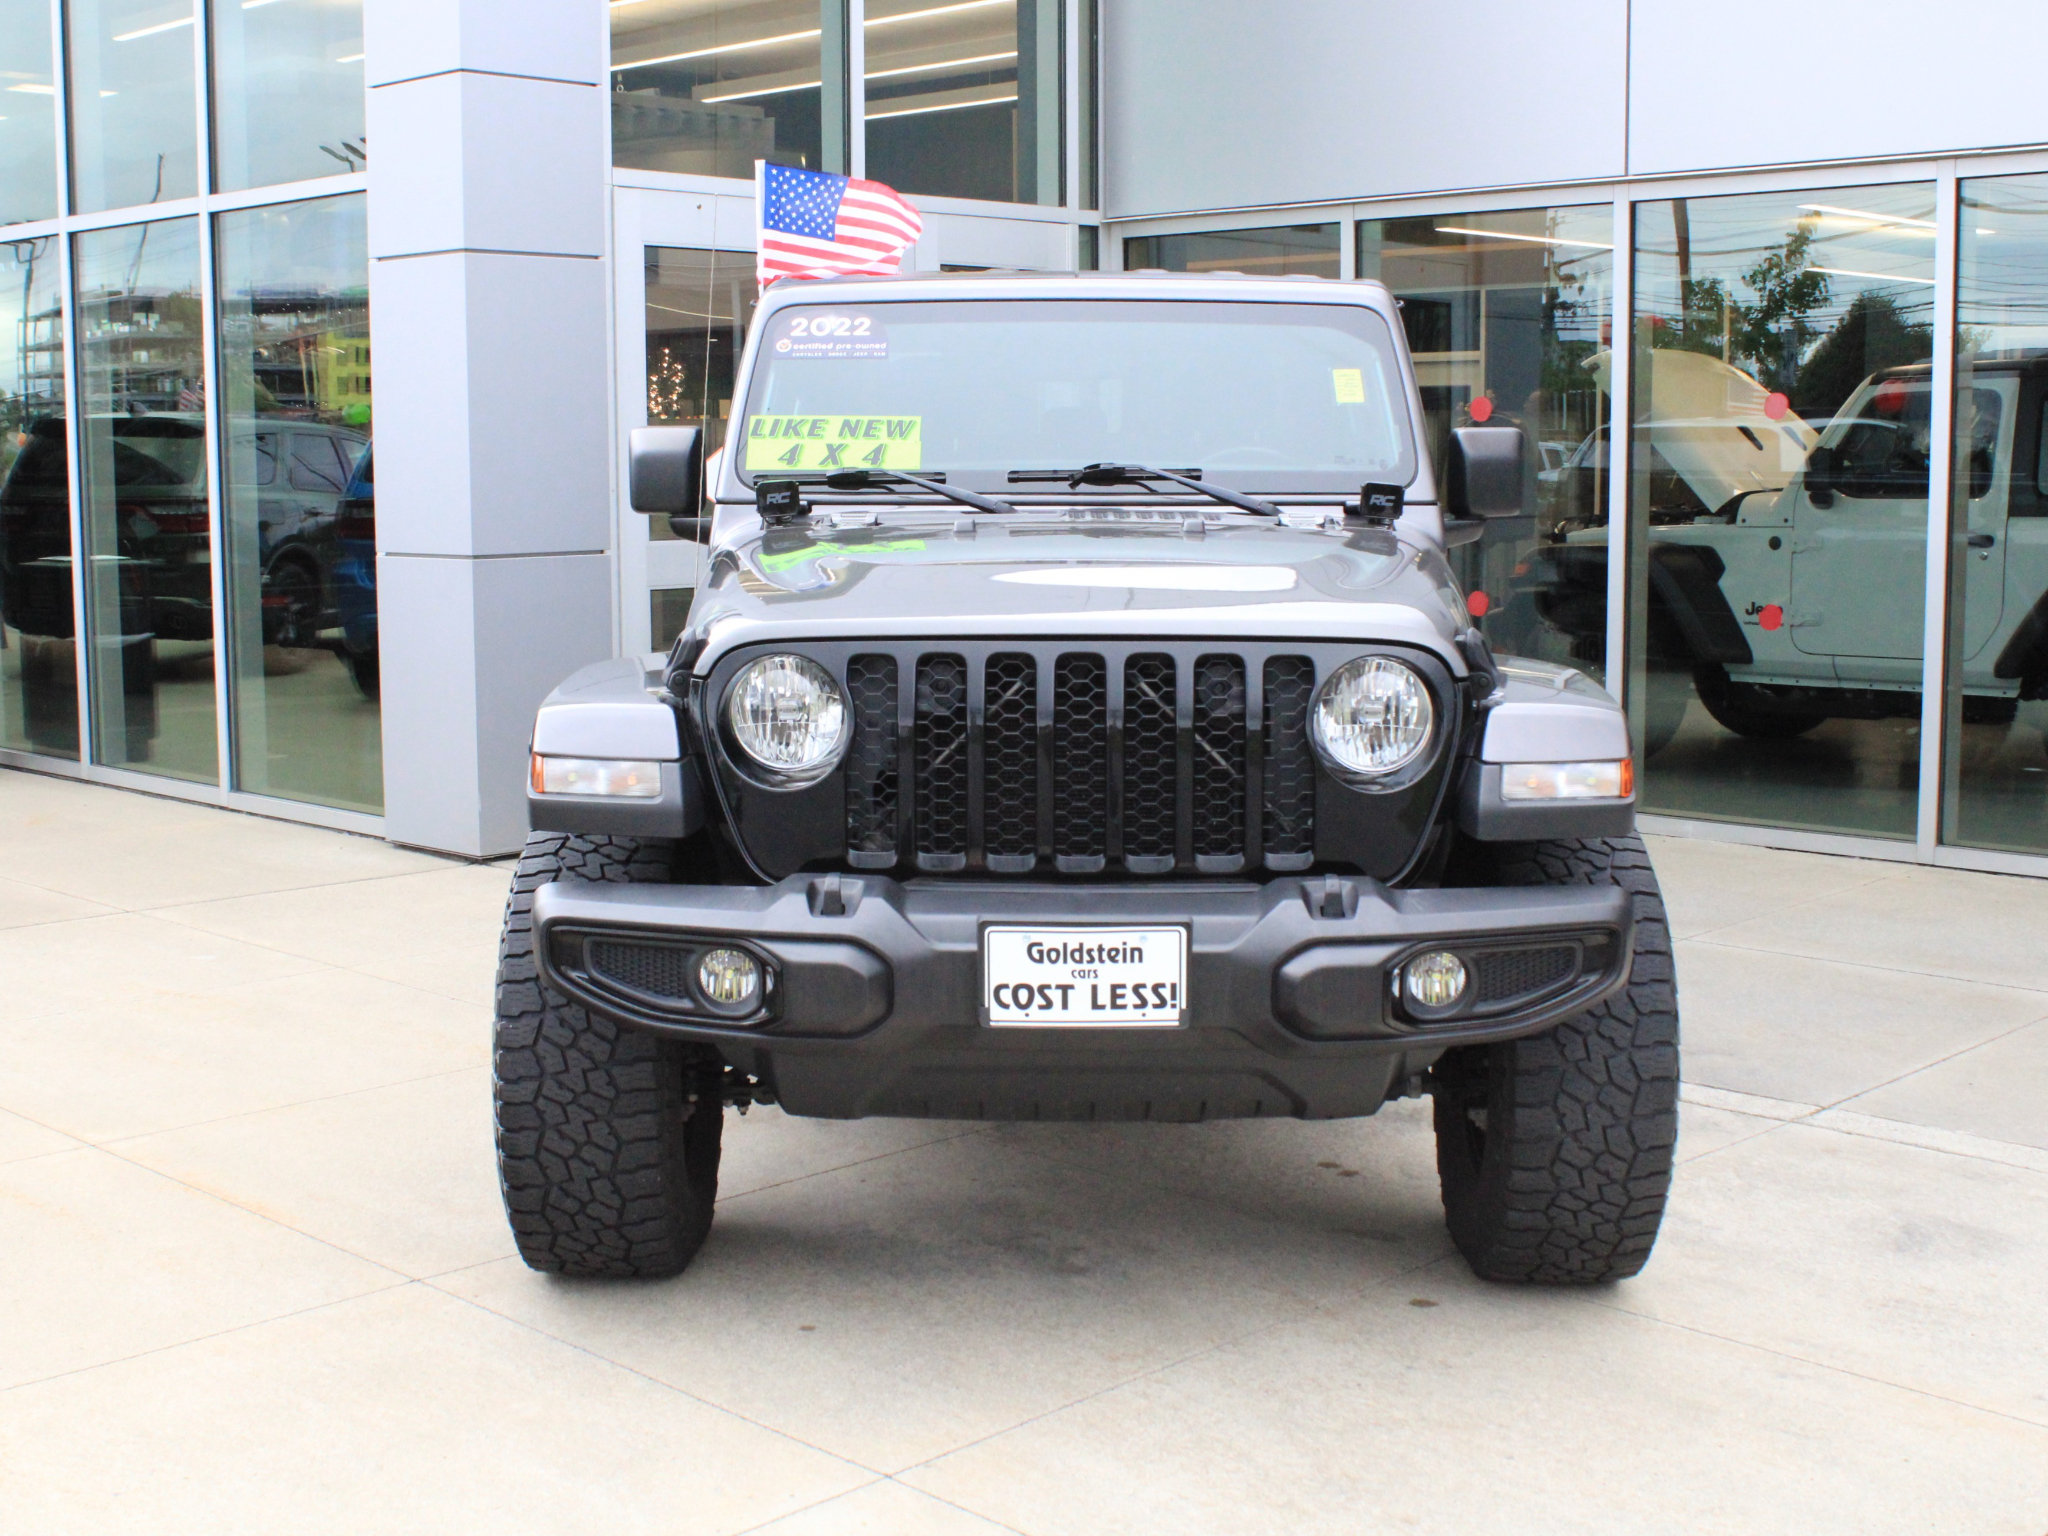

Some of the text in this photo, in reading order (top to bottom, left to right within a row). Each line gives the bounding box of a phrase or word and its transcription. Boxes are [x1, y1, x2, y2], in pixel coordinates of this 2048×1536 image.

[790, 317, 871, 336] 2022
[793, 342, 833, 350] certified
[750, 418, 915, 440] LIKE NEW
[778, 443, 887, 467] 4 X 4
[1026, 941, 1144, 964] Goldstein
[1071, 968, 1099, 979] cars
[993, 982, 1178, 1011] COST LESS!
